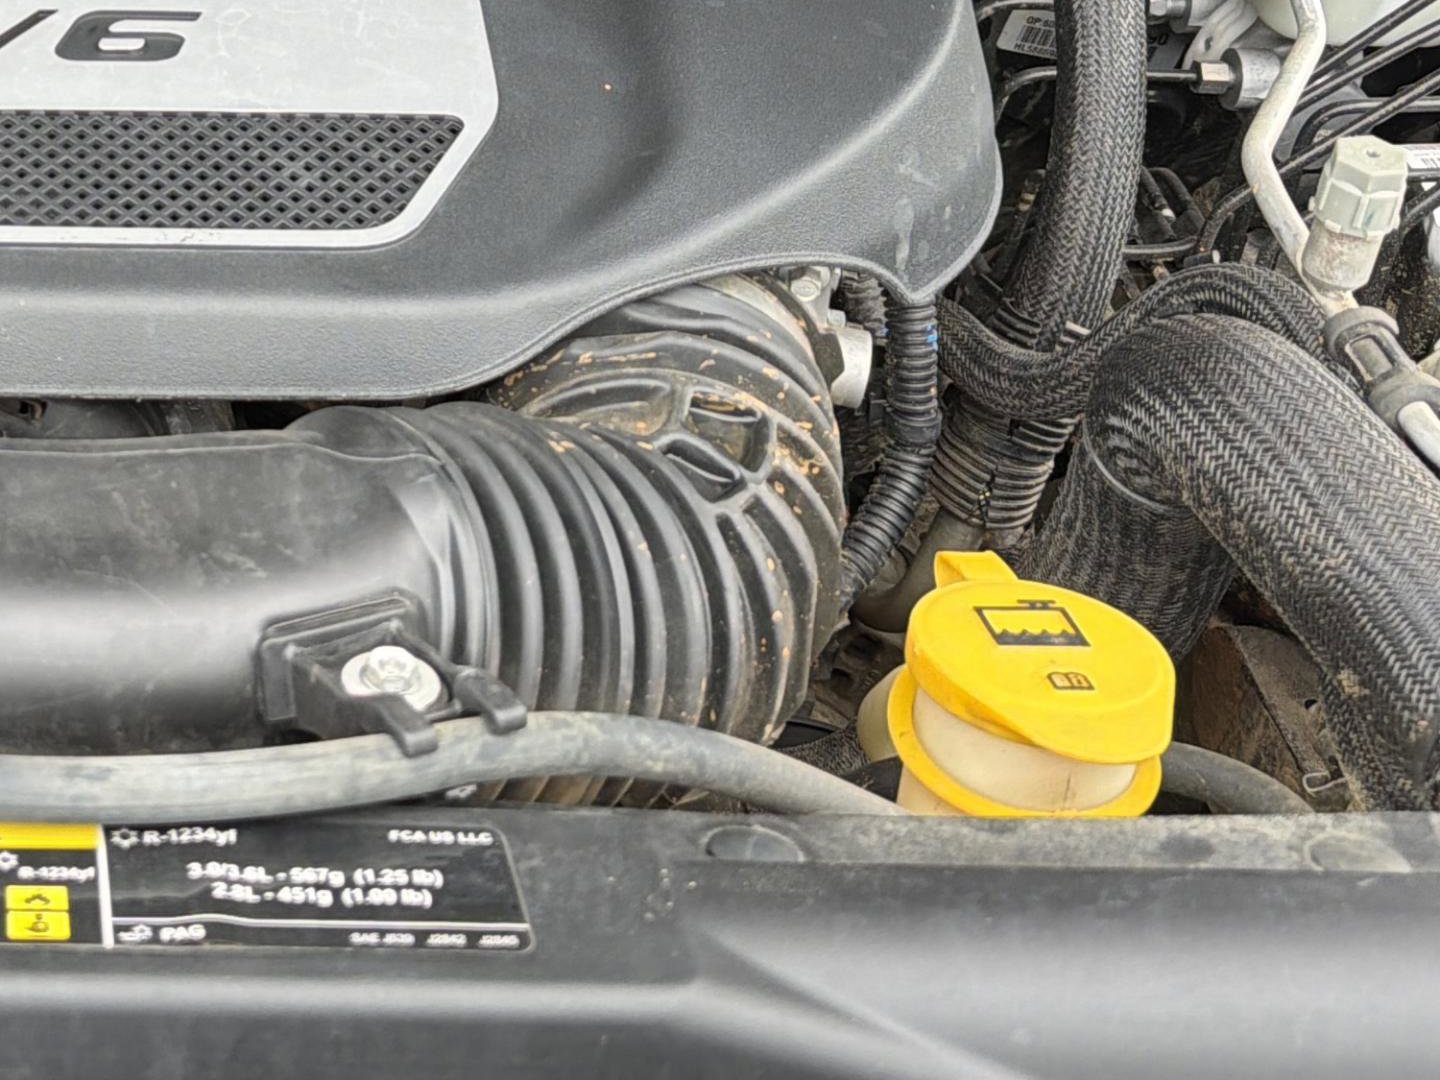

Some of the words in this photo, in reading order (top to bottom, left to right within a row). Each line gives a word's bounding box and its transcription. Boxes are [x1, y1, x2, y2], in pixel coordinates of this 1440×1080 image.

[142, 827, 237, 846] R-1234yf
[387, 829, 427, 844] FCA
[428, 830, 455, 845] US
[457, 831, 494, 846] LLC
[289, 867, 345, 888] 567g
[353, 868, 409, 887] (1.25
[411, 868, 444, 889] lb)
[277, 887, 334, 908] 451g
[400, 888, 433, 909] lb)
[160, 924, 207, 944] PAG
